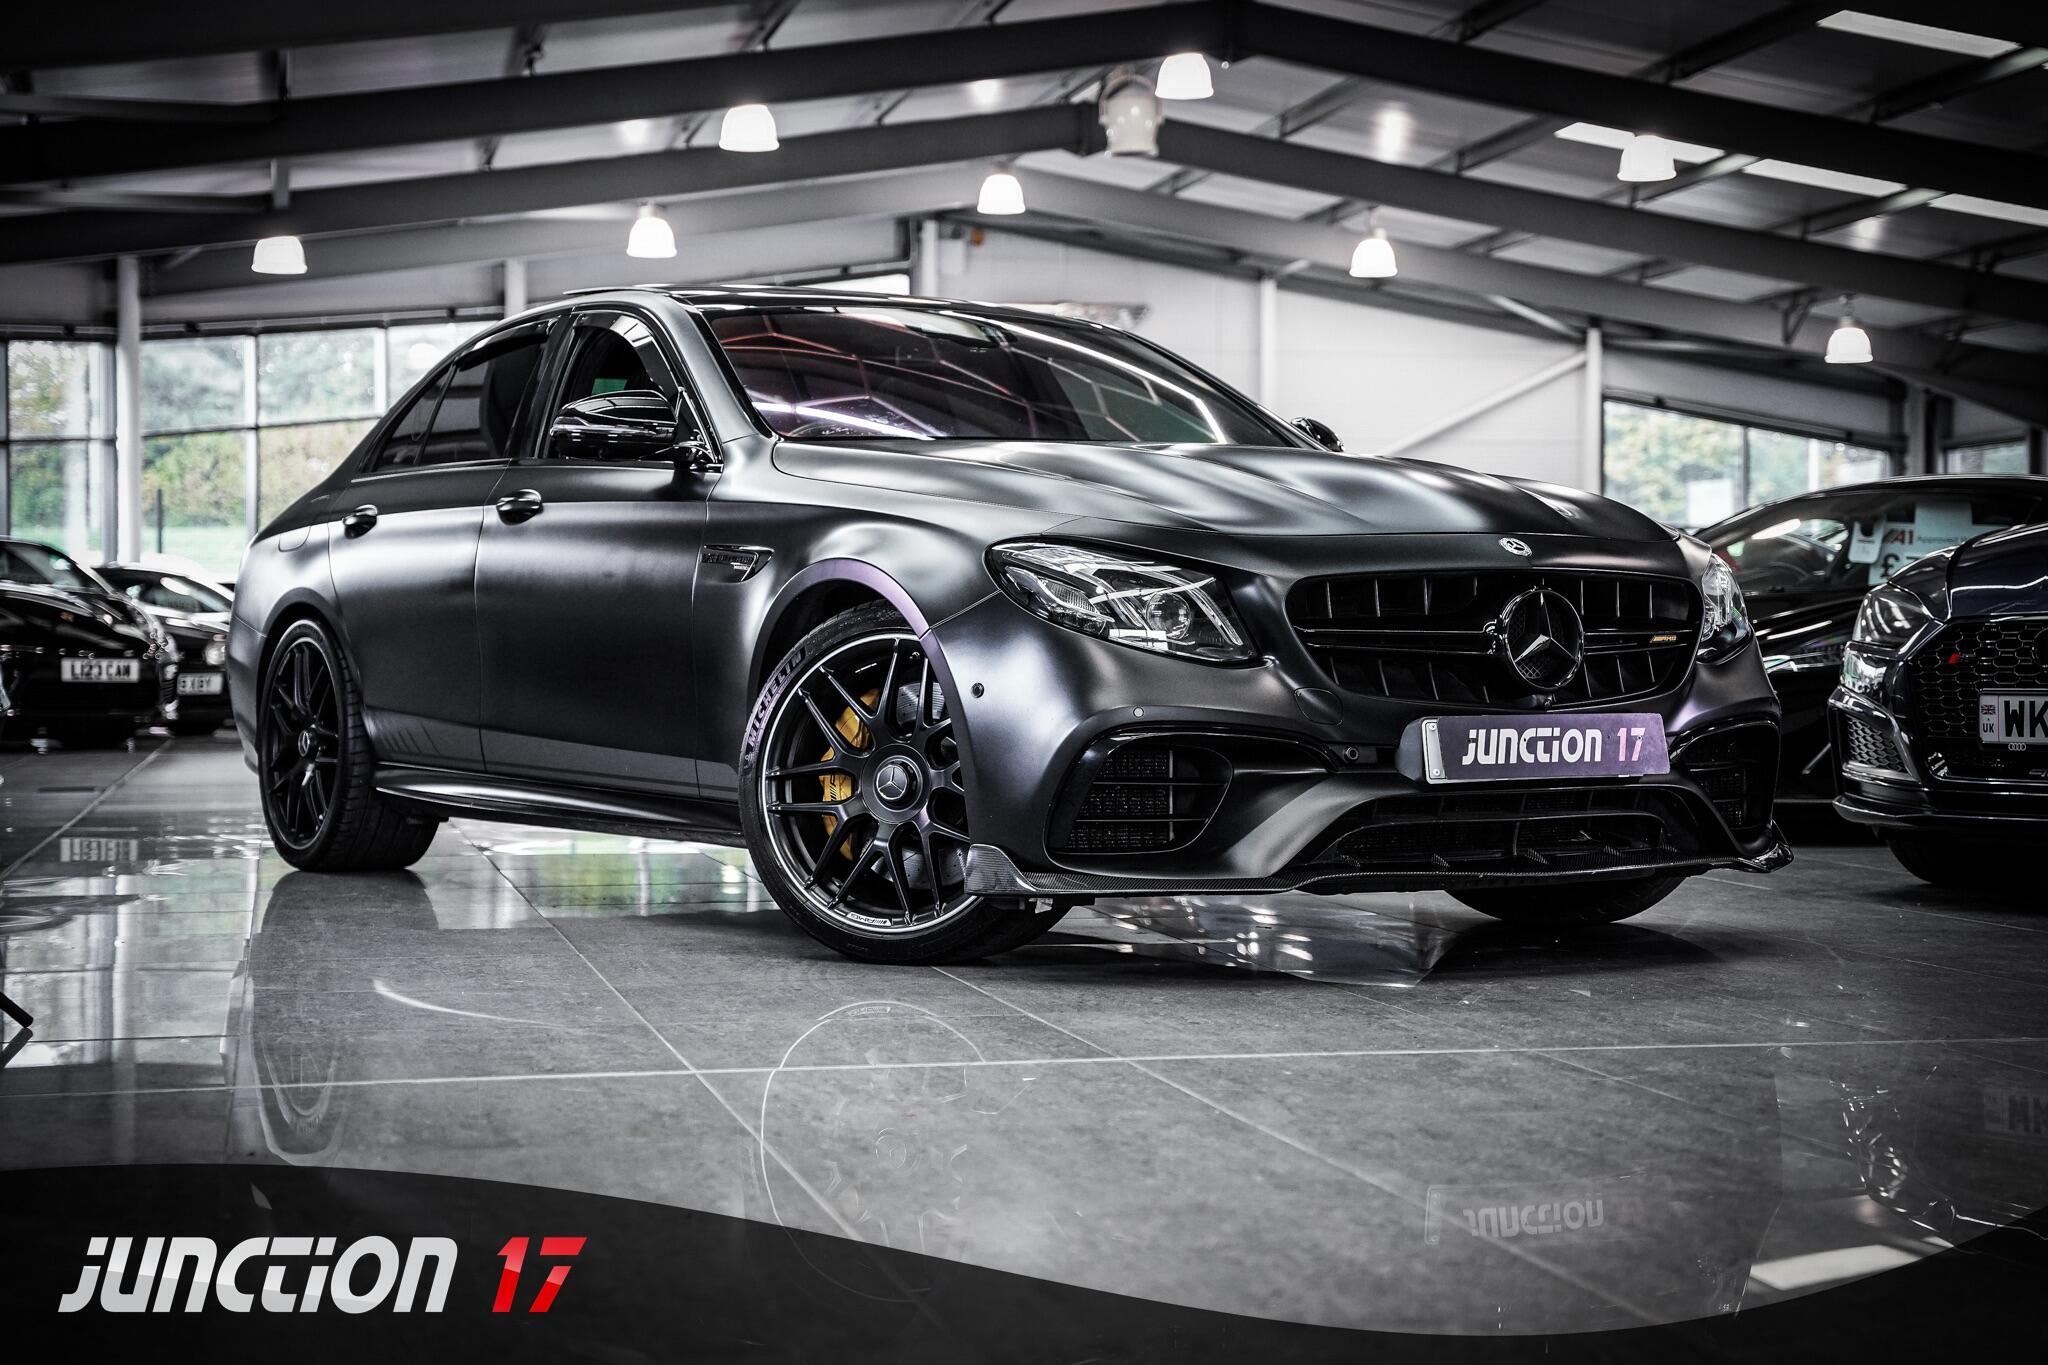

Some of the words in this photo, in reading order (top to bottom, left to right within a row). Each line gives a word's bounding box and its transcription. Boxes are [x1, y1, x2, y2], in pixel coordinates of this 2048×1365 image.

[747, 652, 803, 747] MICHELIN
[1983, 723, 1994, 733] UK
[2003, 700, 2048, 738] WK
[1462, 727, 1603, 766] JUNCTION
[1616, 727, 1646, 762] 17
